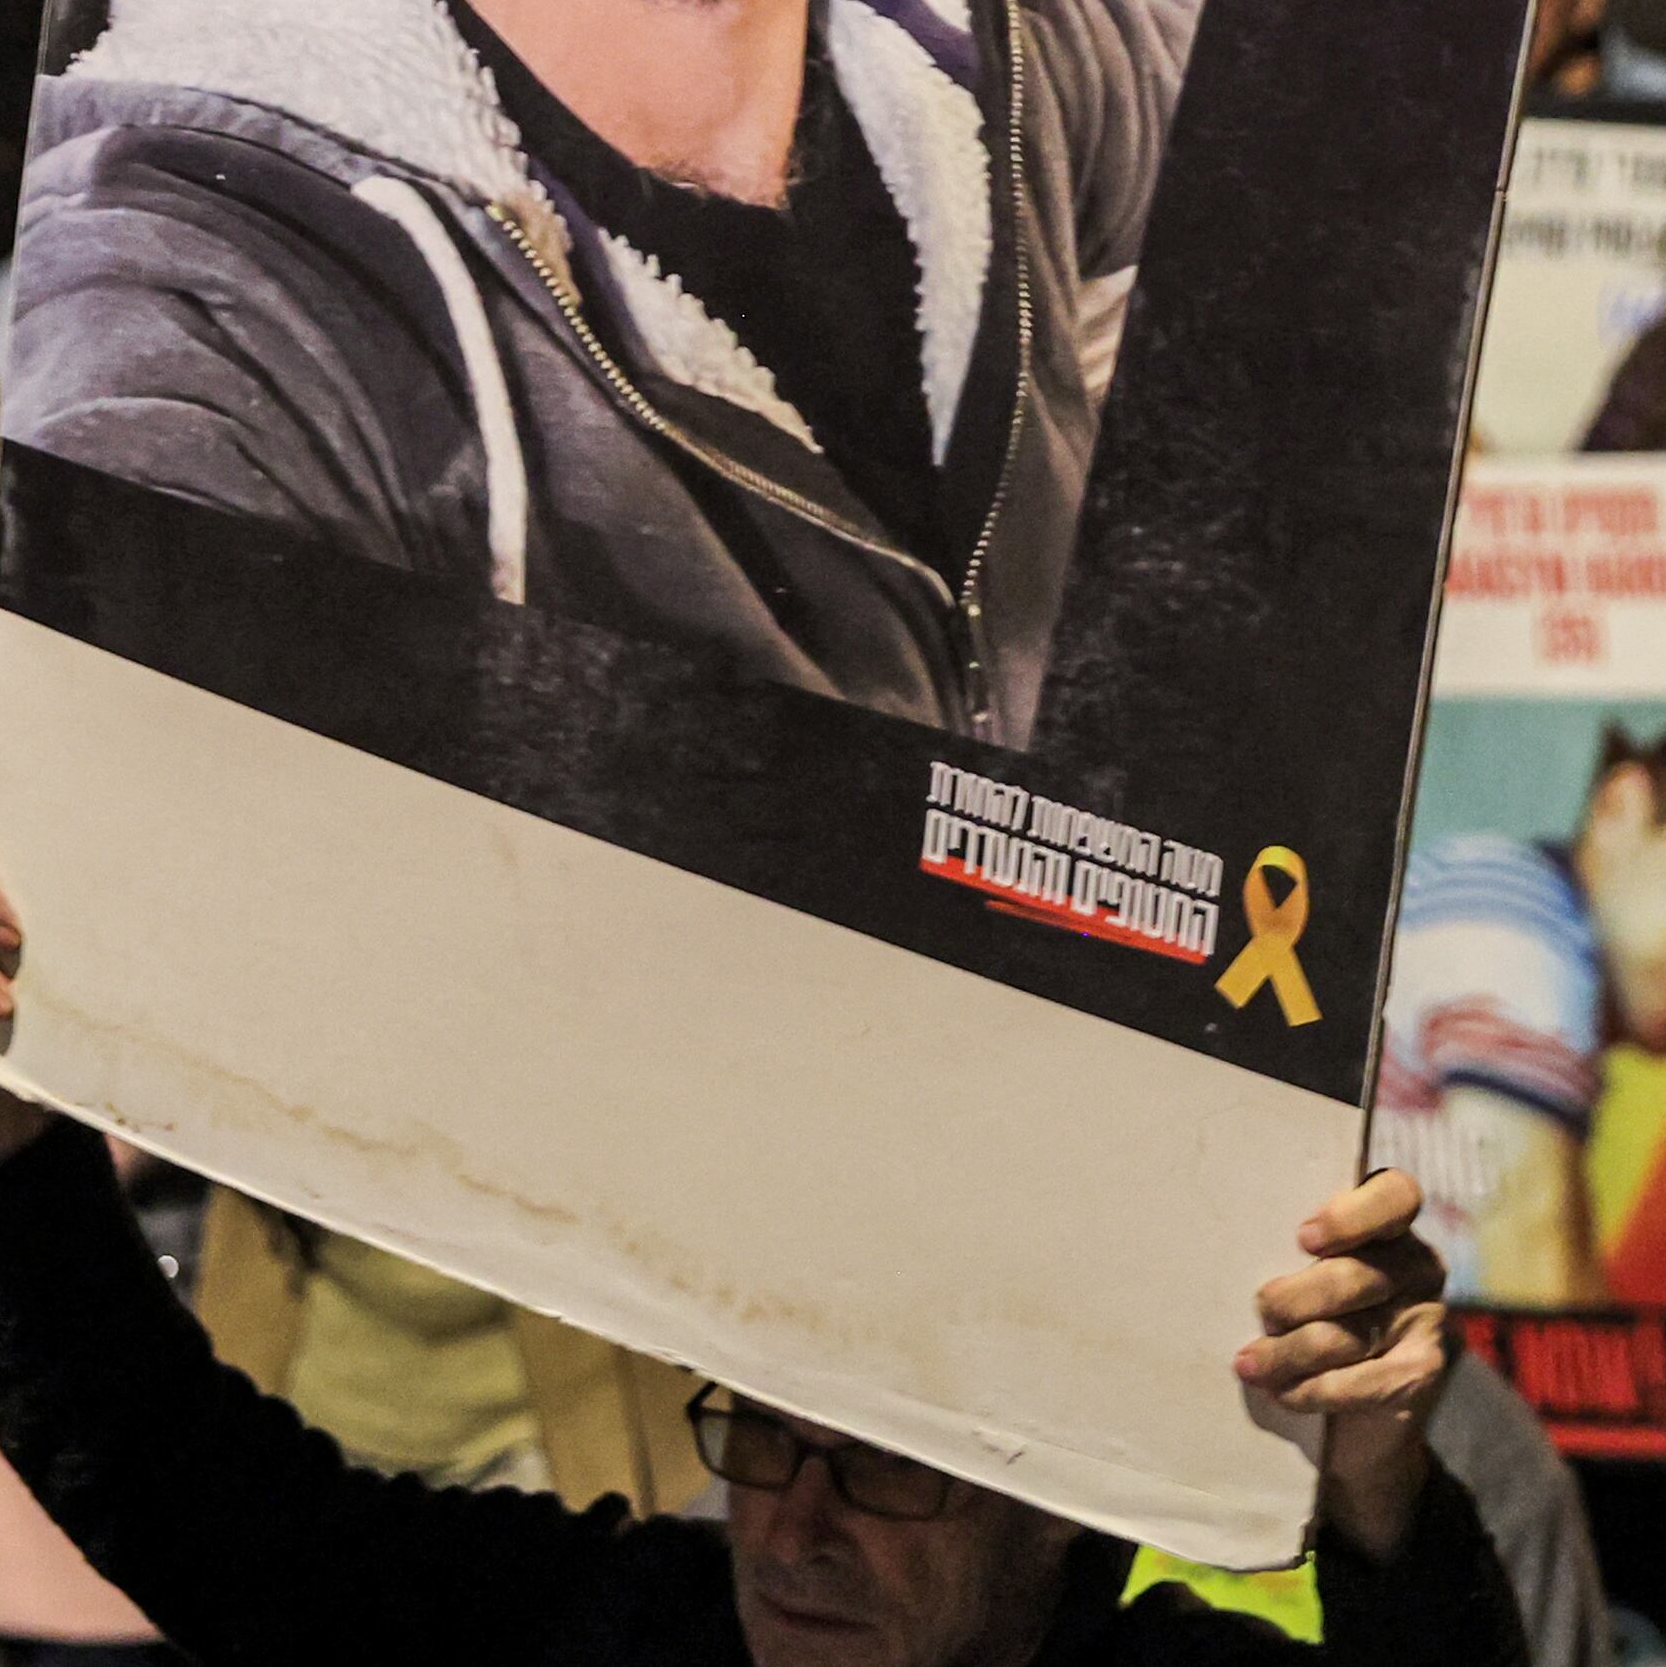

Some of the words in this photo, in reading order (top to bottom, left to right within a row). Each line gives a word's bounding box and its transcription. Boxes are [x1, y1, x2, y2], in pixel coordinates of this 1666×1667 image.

[922, 807, 1071, 907] והנעדרים
[1070, 857, 1221, 957] החטופים
[1160, 838, 1224, 897] מטה
